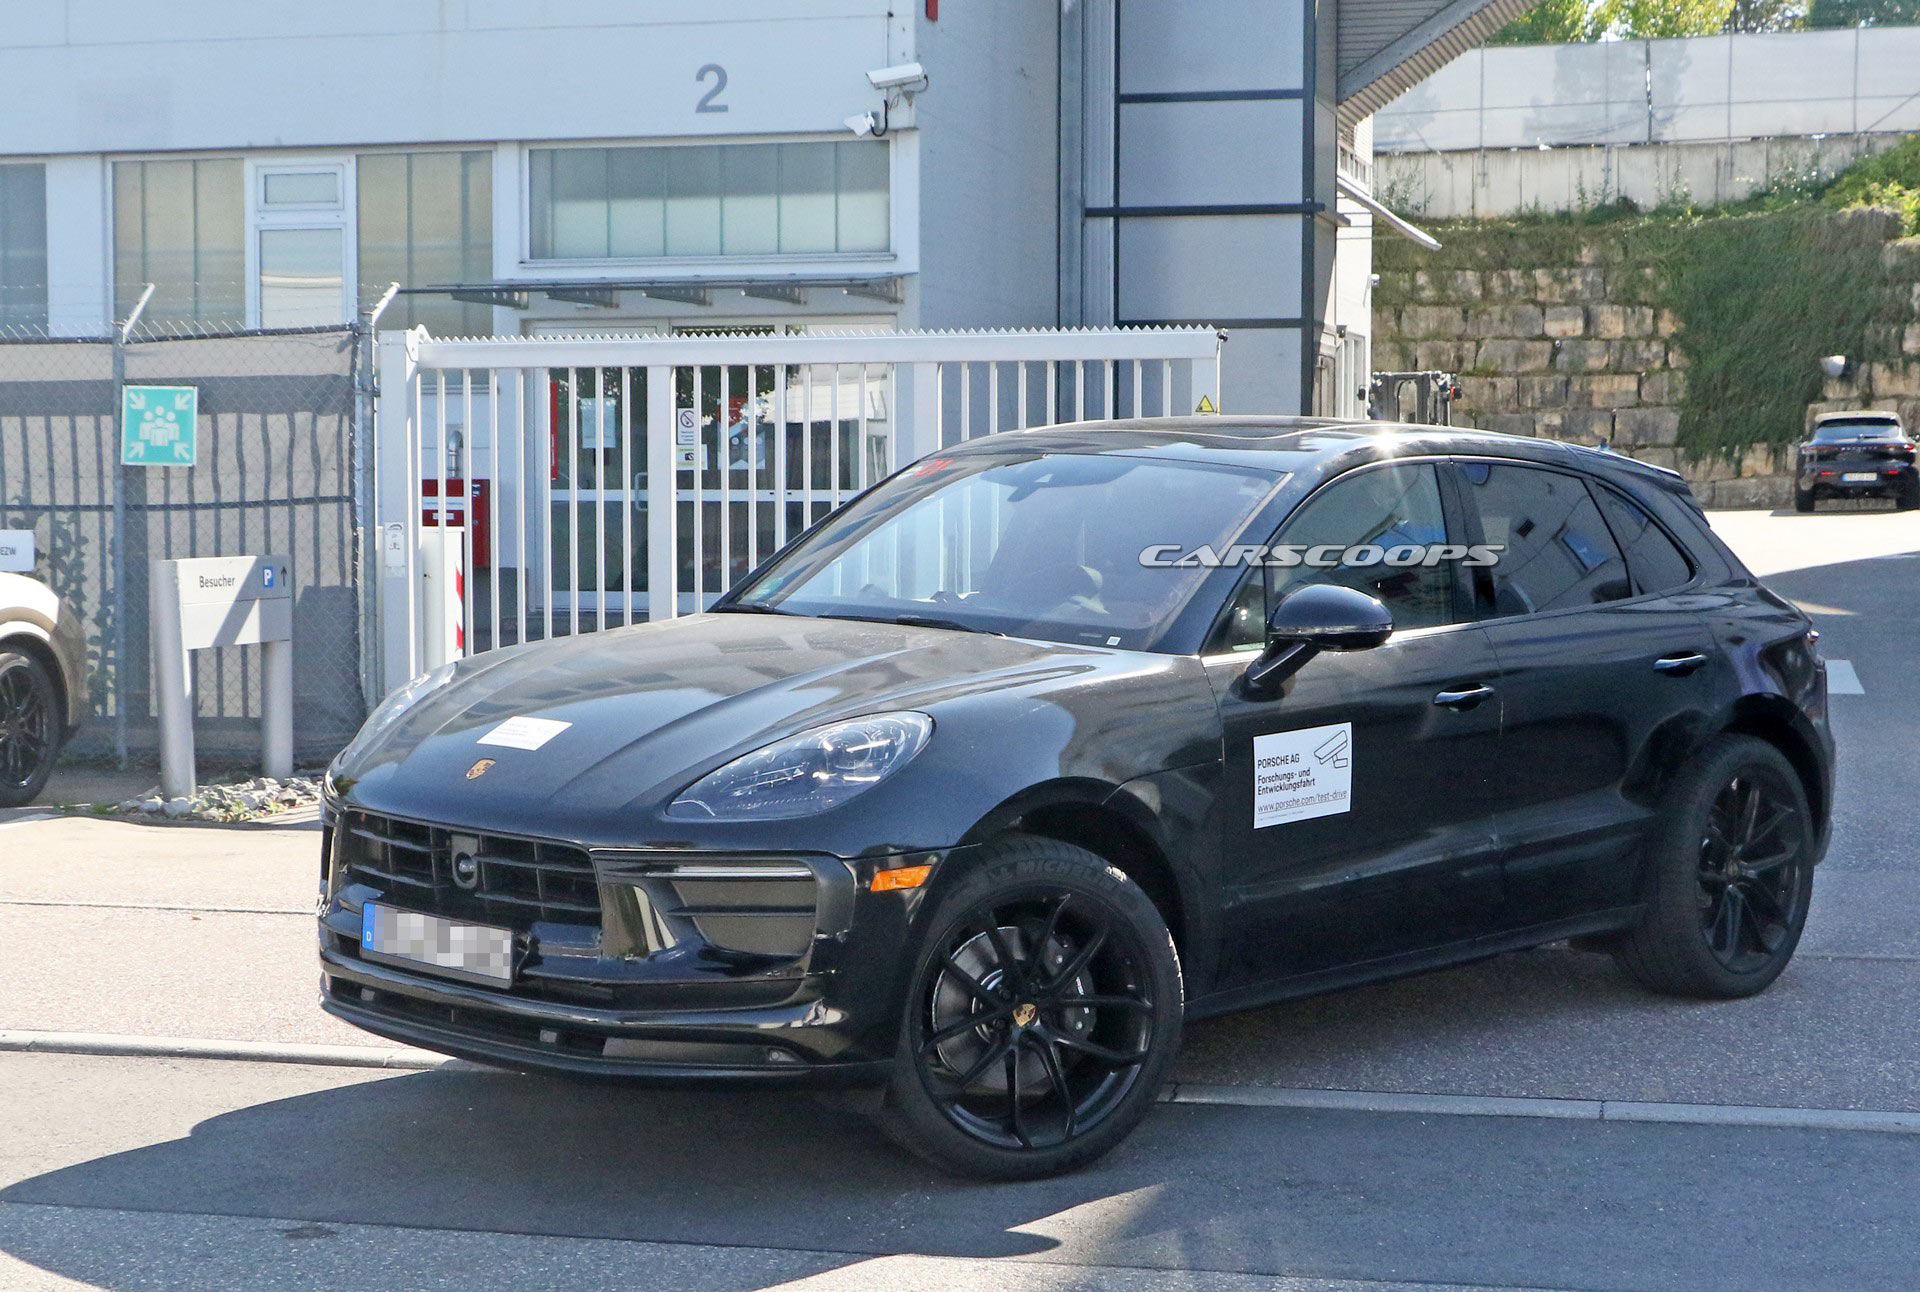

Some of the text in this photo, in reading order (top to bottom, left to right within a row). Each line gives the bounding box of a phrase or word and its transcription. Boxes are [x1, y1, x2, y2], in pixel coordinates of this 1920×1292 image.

[695, 63, 729, 114] 2
[199, 568, 272, 588] Besucher P
[1257, 753, 1300, 769] PORSCHE AG
[1257, 767, 1311, 785] Forschungs- und
[1257, 778, 1316, 796] Entwicklungsfahrt
[1257, 790, 1348, 813] www.porsche.com/test-drive
[365, 931, 372, 942] D
